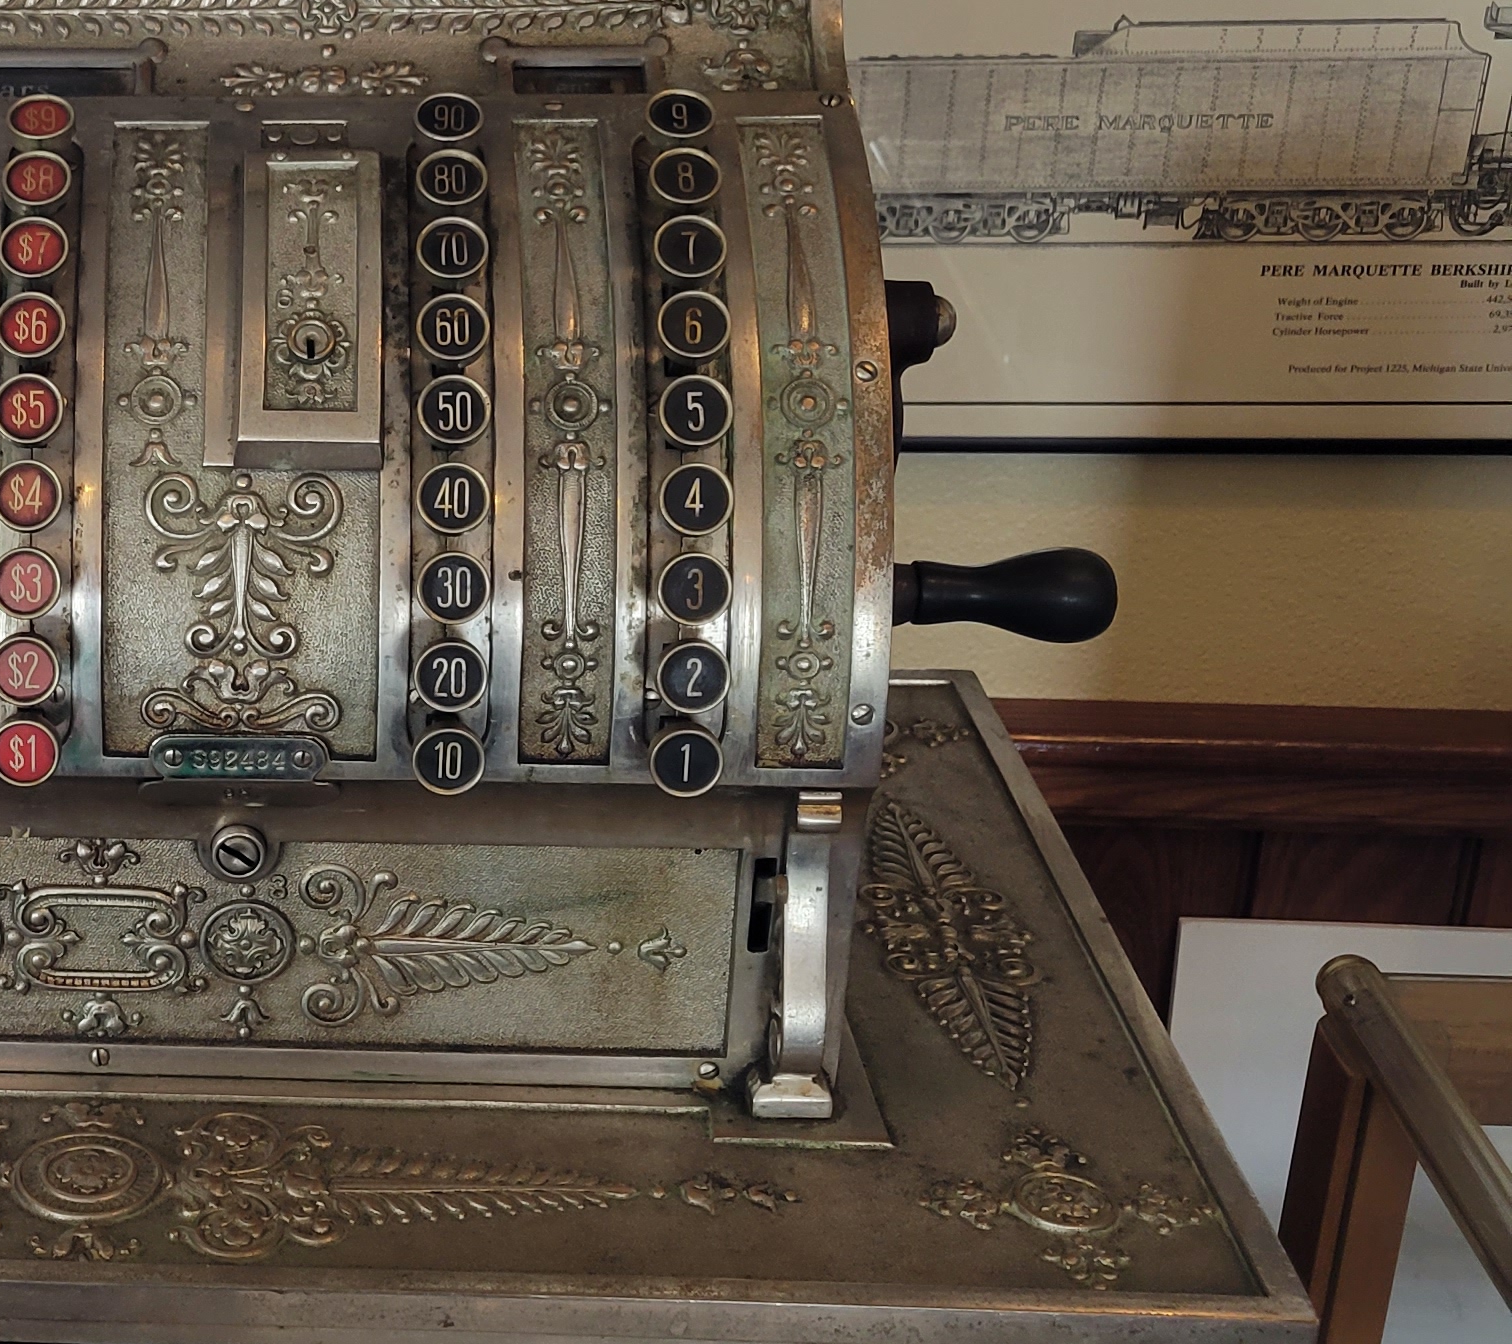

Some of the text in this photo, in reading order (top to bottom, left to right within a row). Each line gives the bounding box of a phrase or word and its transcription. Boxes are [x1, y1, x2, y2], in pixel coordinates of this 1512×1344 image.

[1003, 113, 1275, 133] PERE MARQUETTE
[17, 231, 51, 266] $7
[436, 231, 468, 266] 70
[680, 230, 700, 265] 7
[1260, 264, 1305, 277] PERE
[1312, 263, 1423, 279] MARQUETTE
[1460, 279, 1500, 289] Built by
[1275, 312, 1344, 321] Tractive Force
[1277, 297, 1359, 307] Weight of Engine
[13, 307, 47, 345] $6
[435, 307, 470, 346] 60
[684, 307, 702, 345] 6
[1272, 327, 1369, 337] Cylinder Horsepower
[1288, 364, 1332, 373] Produced
[1334, 364, 1348, 373] for
[1350, 364, 1383, 374] Project
[1412, 363, 1457, 374] Michigan
[1459, 364, 1483, 372] State
[11, 389, 45, 429] $5
[438, 391, 473, 432] 50
[686, 391, 705, 432] 5
[8, 473, 43, 515] $4
[433, 476, 470, 519] 40
[684, 477, 704, 518] 4
[9, 562, 43, 604] $3
[436, 565, 472, 608] 30
[685, 568, 703, 611] 3
[7, 650, 40, 690] $2
[432, 656, 467, 698] 20
[686, 657, 703, 697] 2
[8, 733, 37, 774] $1
[434, 741, 463, 780] 10
[680, 743, 691, 783] 1
